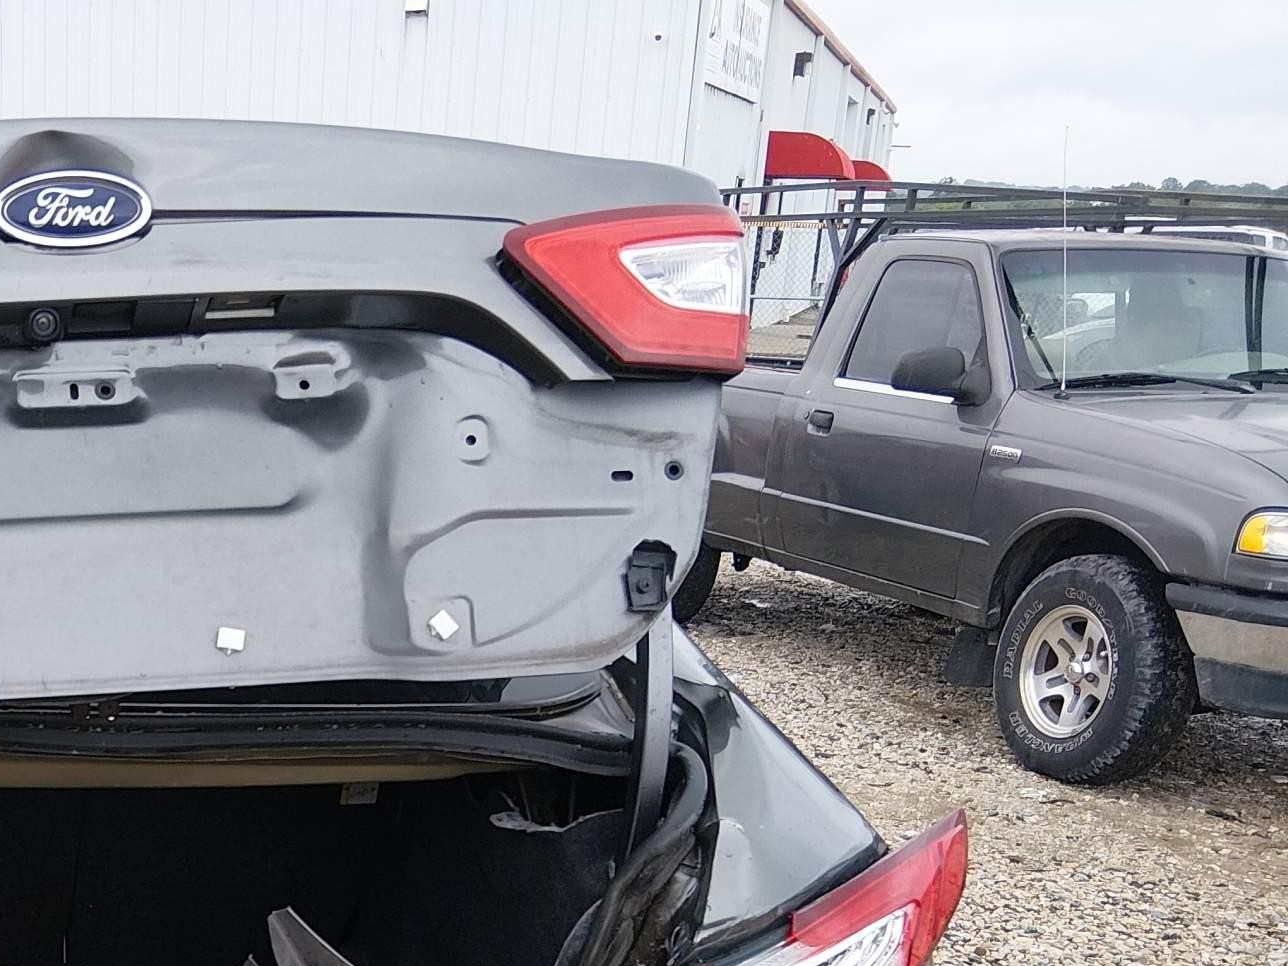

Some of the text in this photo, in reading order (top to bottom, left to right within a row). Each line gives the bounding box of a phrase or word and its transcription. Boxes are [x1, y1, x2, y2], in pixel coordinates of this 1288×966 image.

[28, 187, 116, 228] Ford
[1003, 600, 1043, 678] RADIAL
[1008, 711, 1094, 754] WRANGLER
